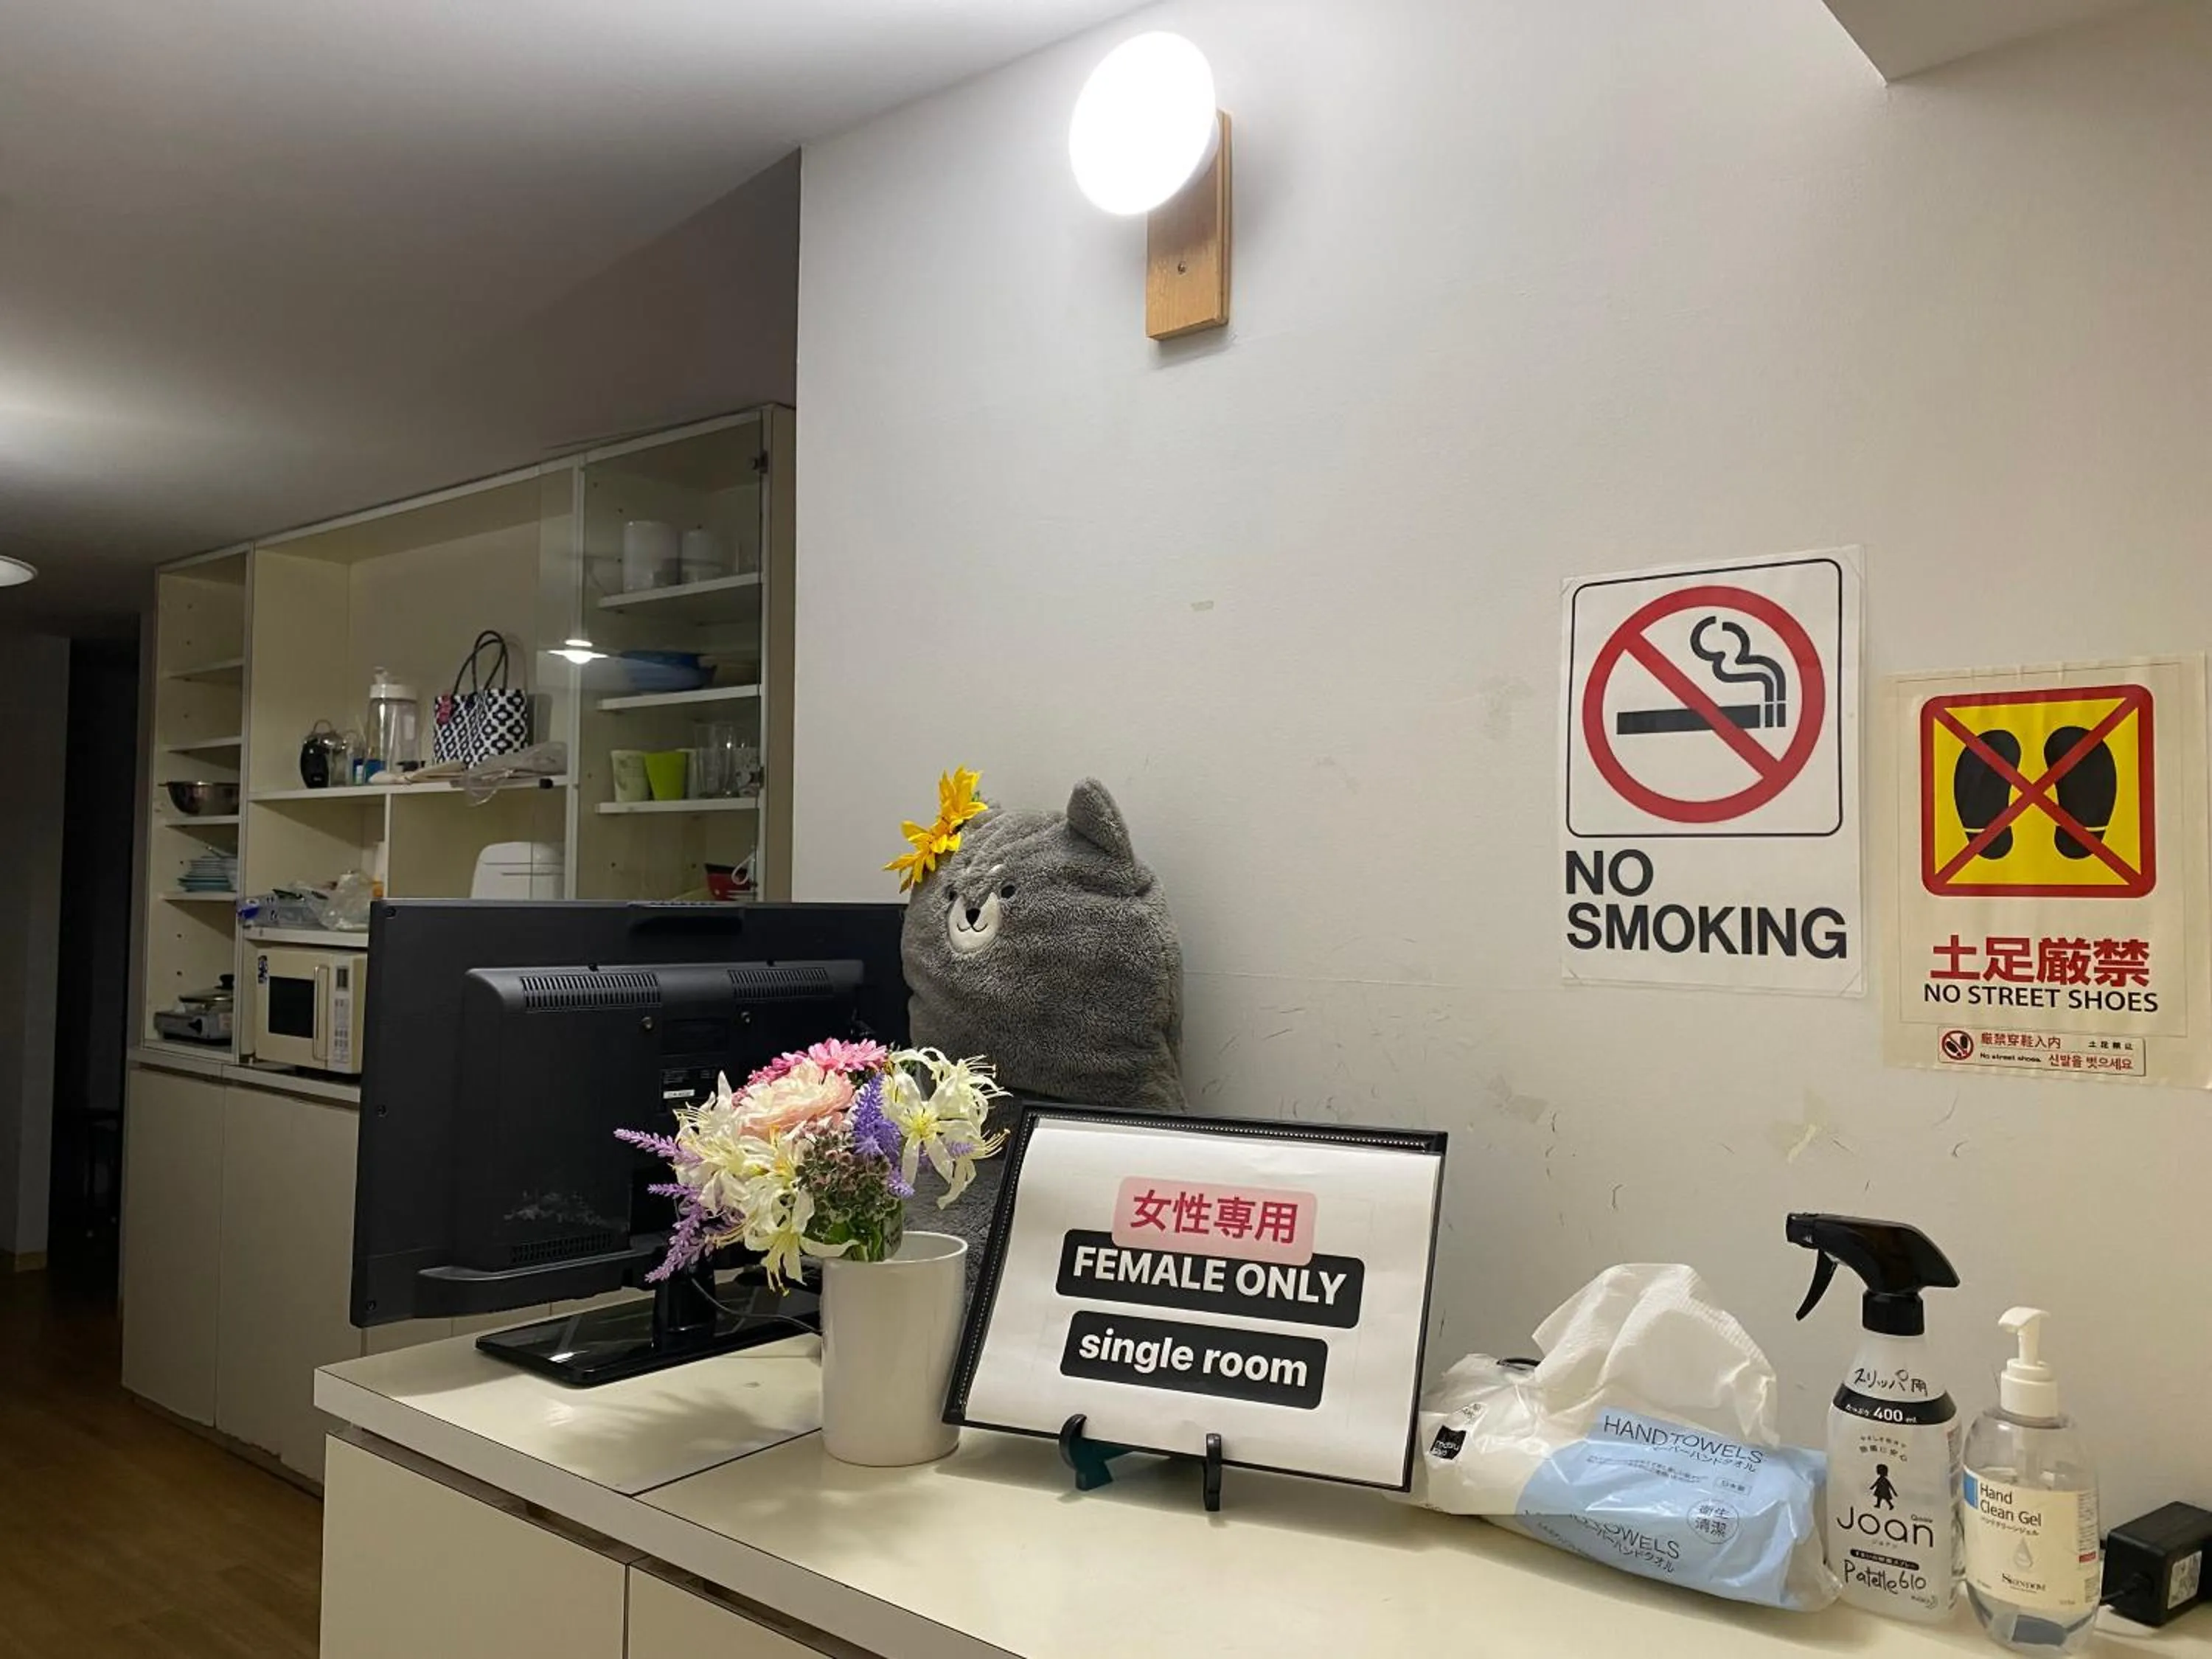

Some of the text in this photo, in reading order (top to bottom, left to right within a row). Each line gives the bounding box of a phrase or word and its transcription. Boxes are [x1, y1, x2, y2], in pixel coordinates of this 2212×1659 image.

[1566, 849, 1654, 897] NO
[1566, 902, 1847, 959] SMOKING
[1930, 934, 2150, 987] 土足厳禁
[1924, 983, 2158, 1012] NO STREET SHOES
[2086, 1056, 2134, 1071] 벗으세요
[1130, 1189, 1298, 1245] 女性専用
[1073, 1245, 1347, 1305] FEMALE ONLY
[1078, 1329, 1308, 1387] single room
[1874, 1407, 1903, 1422] 400
[1980, 1482, 2013, 1505] Hand
[1980, 1499, 2042, 1527] Clean Gel
